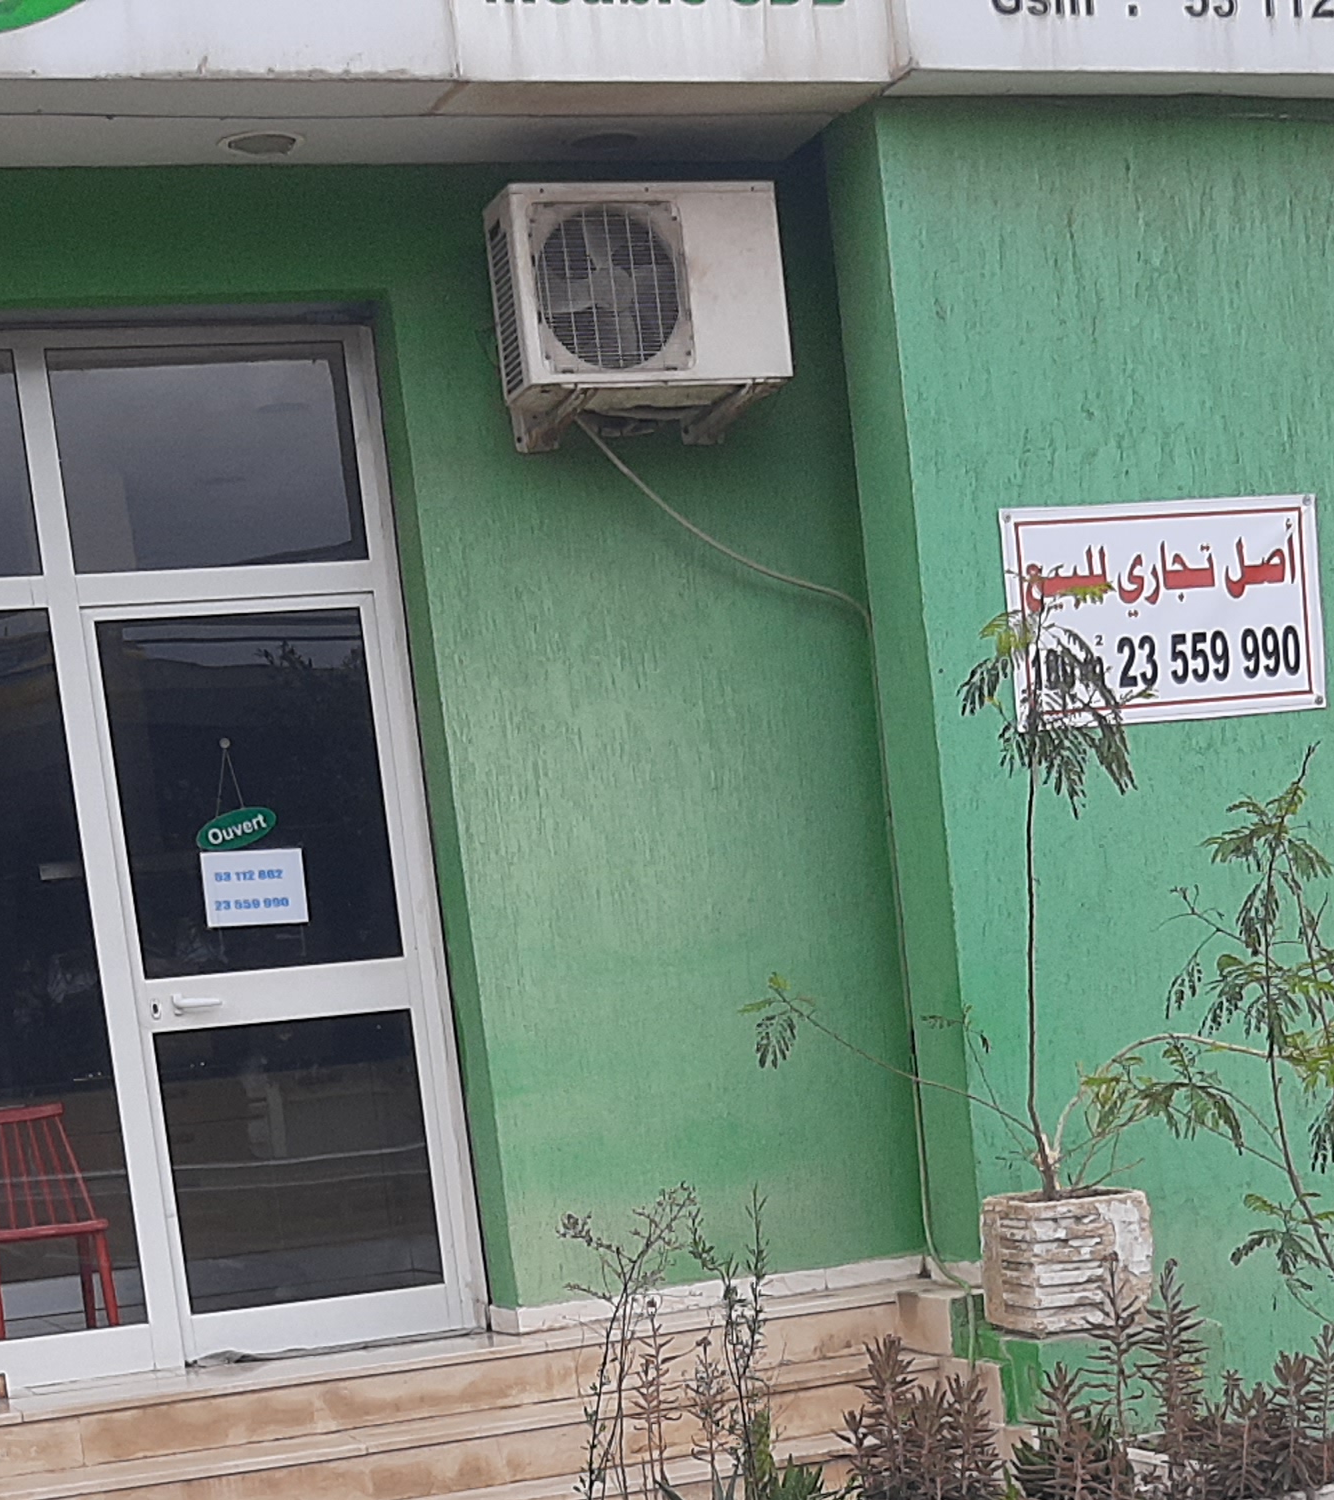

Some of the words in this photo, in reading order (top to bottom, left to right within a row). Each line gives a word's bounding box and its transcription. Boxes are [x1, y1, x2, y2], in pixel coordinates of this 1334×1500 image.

[1118, 540, 1215, 618] تجاري
[1225, 519, 1297, 598] أصل
[1117, 635, 1158, 688] 23
[1170, 631, 1229, 684] 559
[1241, 625, 1301, 679] 990
[208, 814, 267, 844] Ouvert
